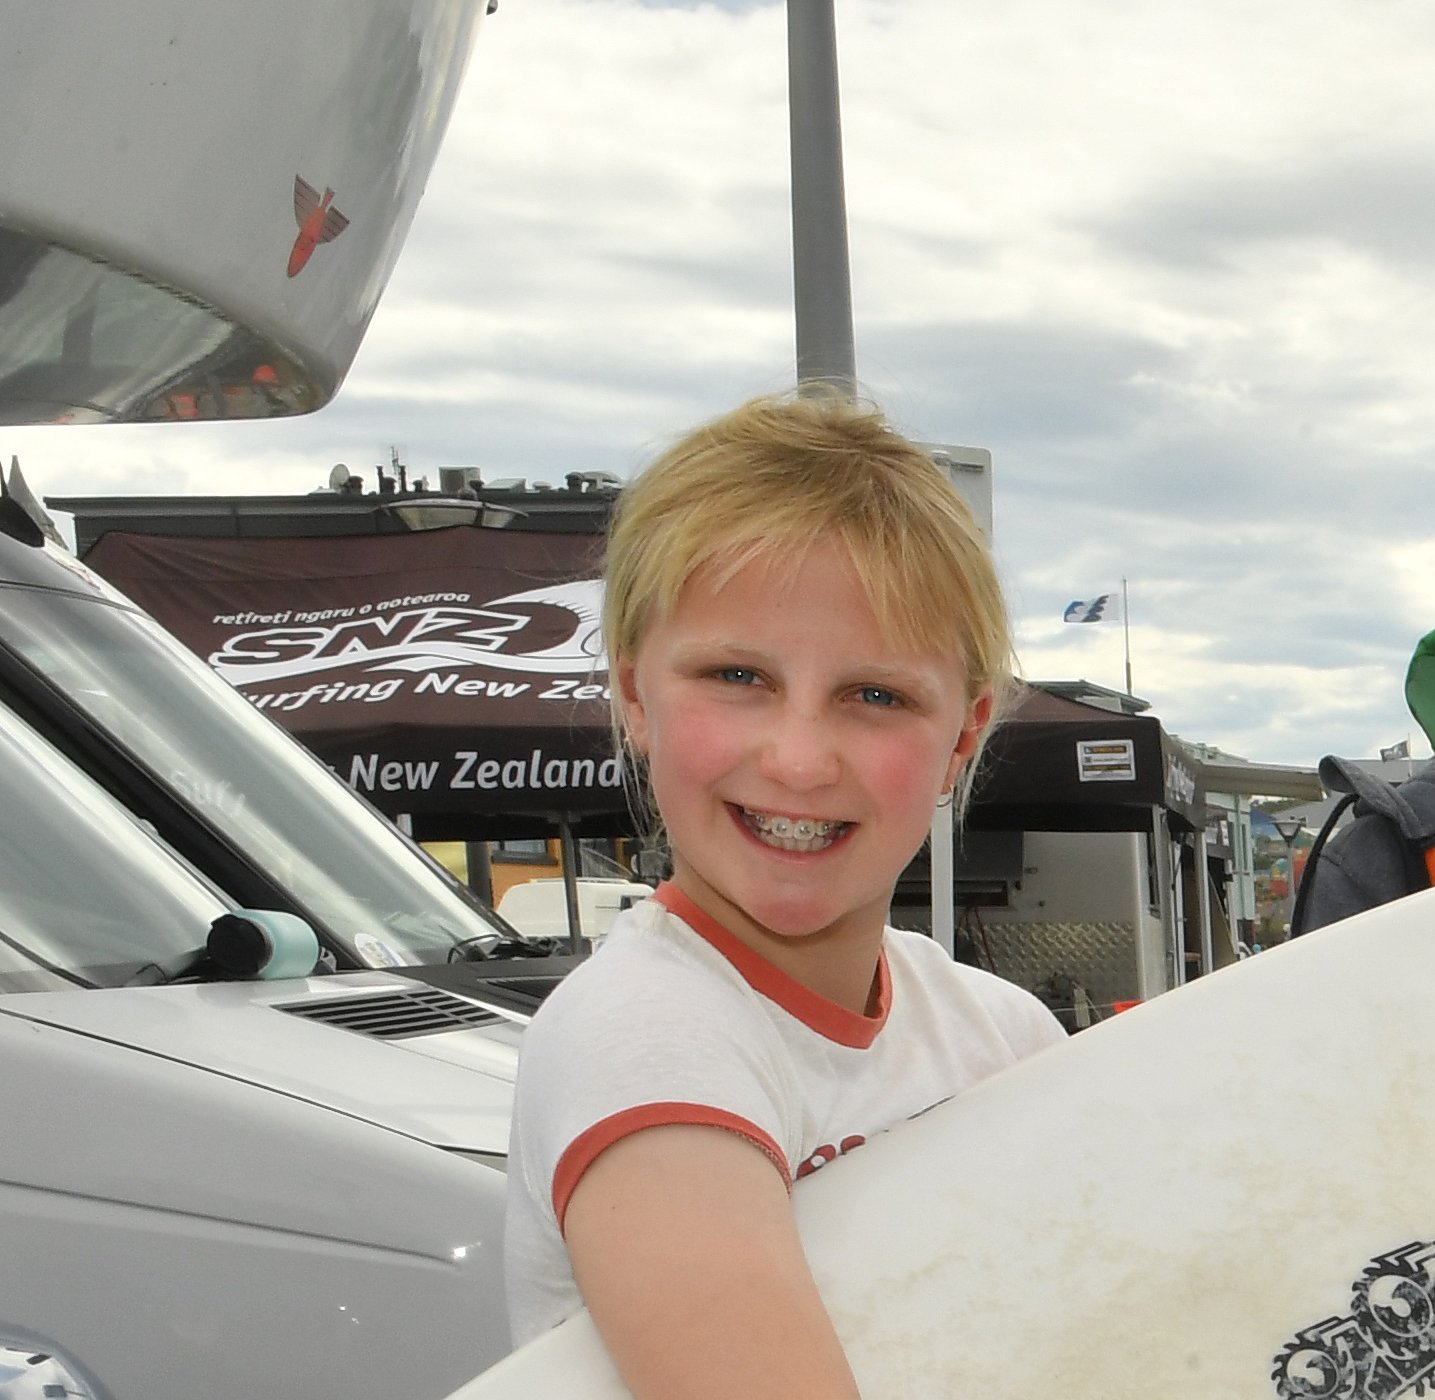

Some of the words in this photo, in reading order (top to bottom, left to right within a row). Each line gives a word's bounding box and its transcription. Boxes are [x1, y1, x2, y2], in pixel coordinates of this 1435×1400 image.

[293, 607, 355, 624] ngaru
[358, 602, 371, 616] o
[376, 591, 472, 612] aotearoa
[240, 677, 404, 712] urfing
[413, 671, 532, 699] New
[349, 752, 440, 792] New
[449, 748, 624, 790] Zealand
